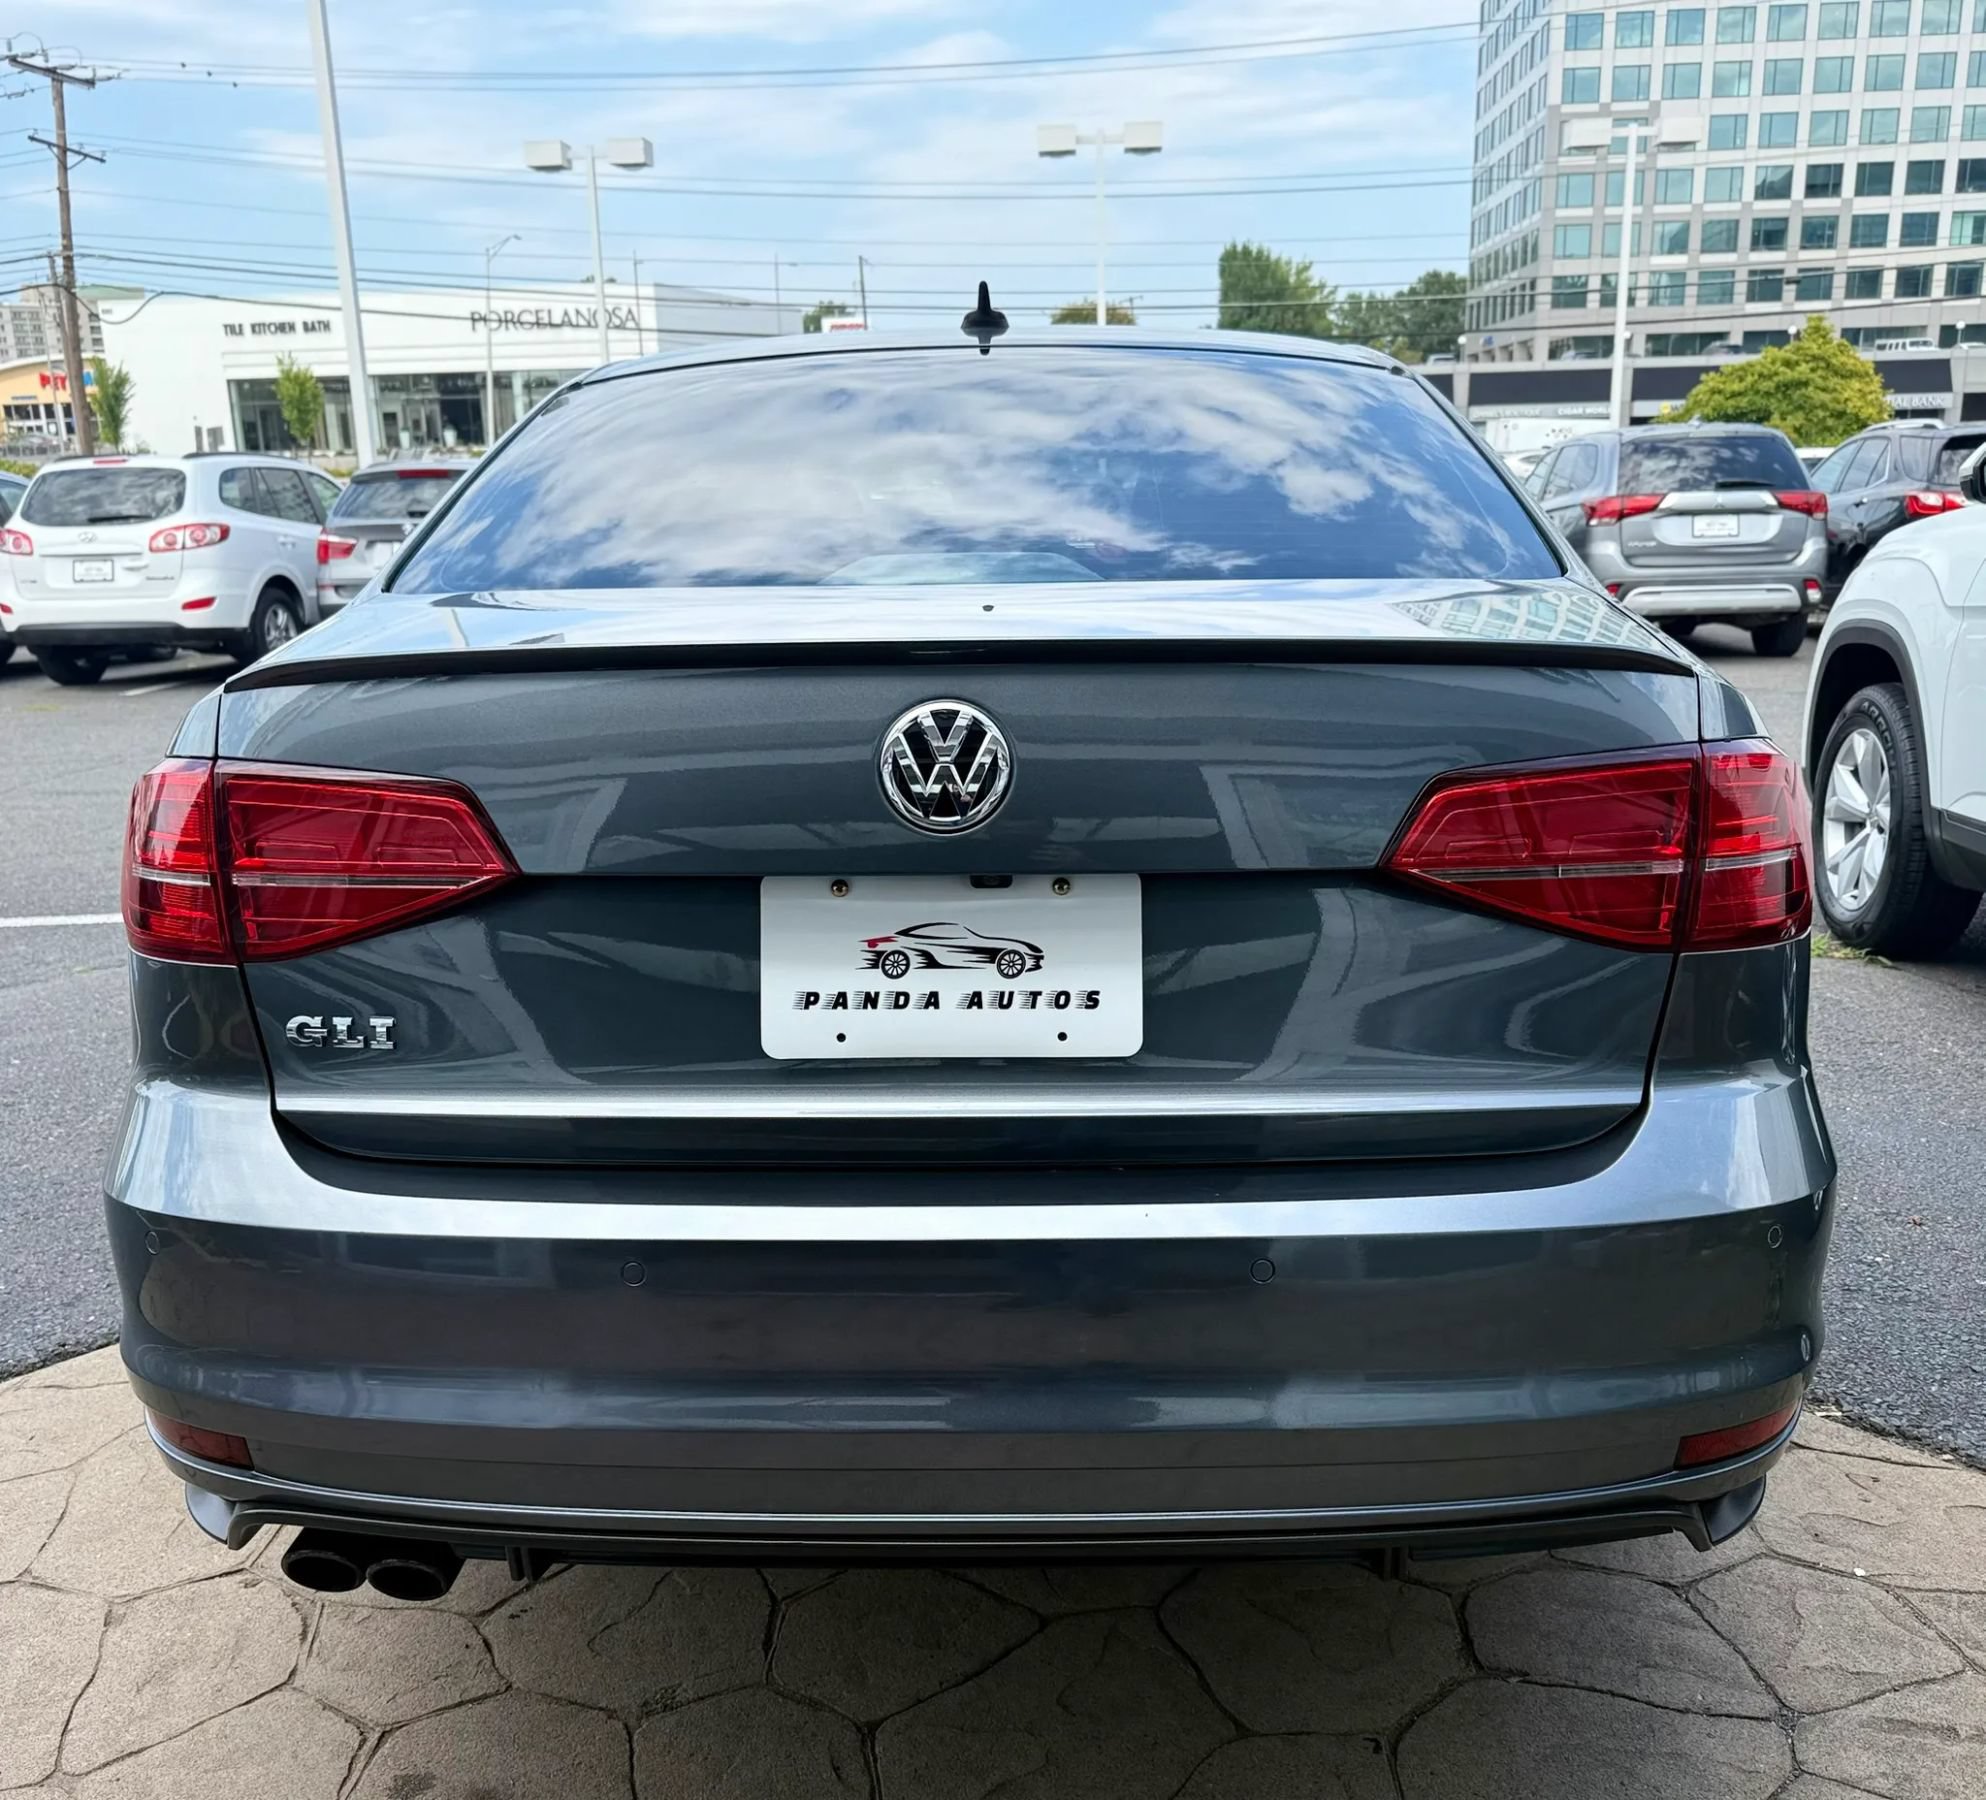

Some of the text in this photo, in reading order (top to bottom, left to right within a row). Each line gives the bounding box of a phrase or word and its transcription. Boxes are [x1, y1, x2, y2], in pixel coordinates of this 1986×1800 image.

[222, 319, 332, 336] TILE KITCHEN BATH
[470, 306, 639, 332] PORCELANOSA
[793, 990, 1101, 1010] PANDA AUTOS
[285, 1014, 396, 1050] GLI
